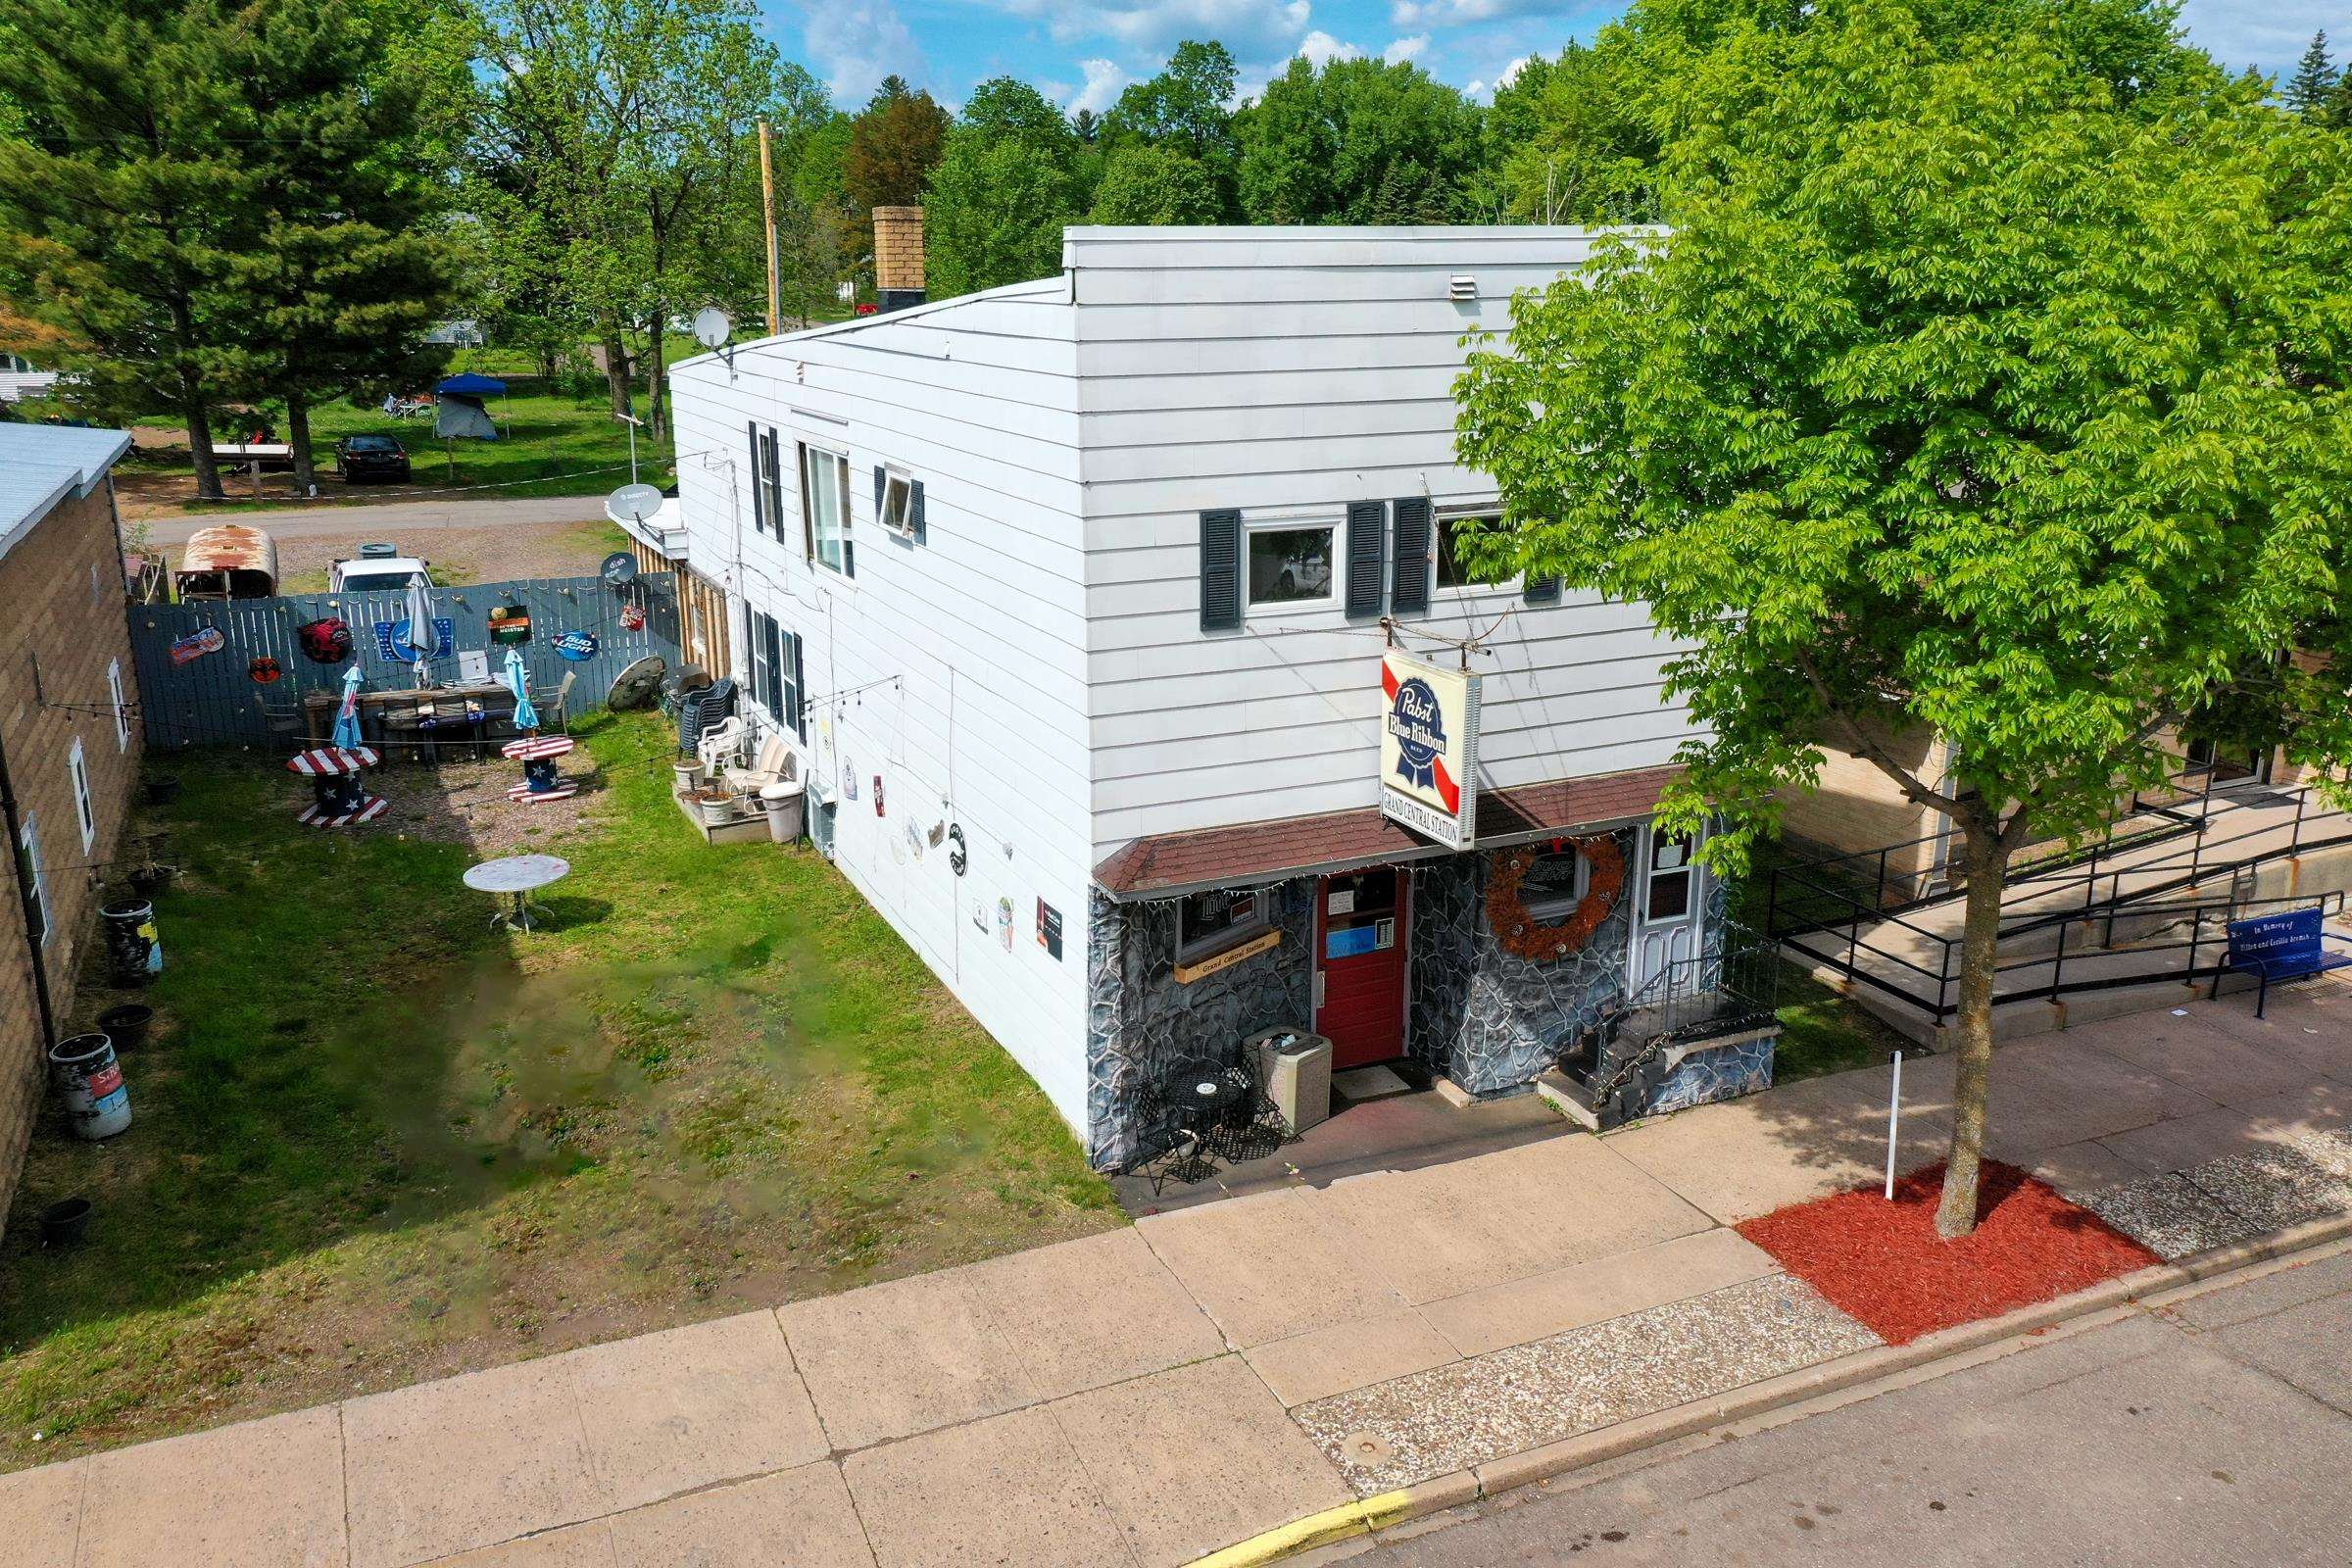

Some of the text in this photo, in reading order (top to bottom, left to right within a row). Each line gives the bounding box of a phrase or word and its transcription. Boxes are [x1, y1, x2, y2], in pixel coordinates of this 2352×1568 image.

[610, 558, 626, 569] dish
[557, 640, 595, 653] LIGHT
[565, 635, 593, 647] BUD
[1401, 687, 1434, 722] Pabst
[1389, 713, 1446, 754] Blue Ribbon
[1410, 744, 1423, 754] BEER
[1384, 792, 1458, 842] GRAND CENTRAL STATION
[2263, 922, 2285, 931] Memory
[2286, 920, 2293, 931] of
[1202, 942, 1265, 973] Grand Central Station
